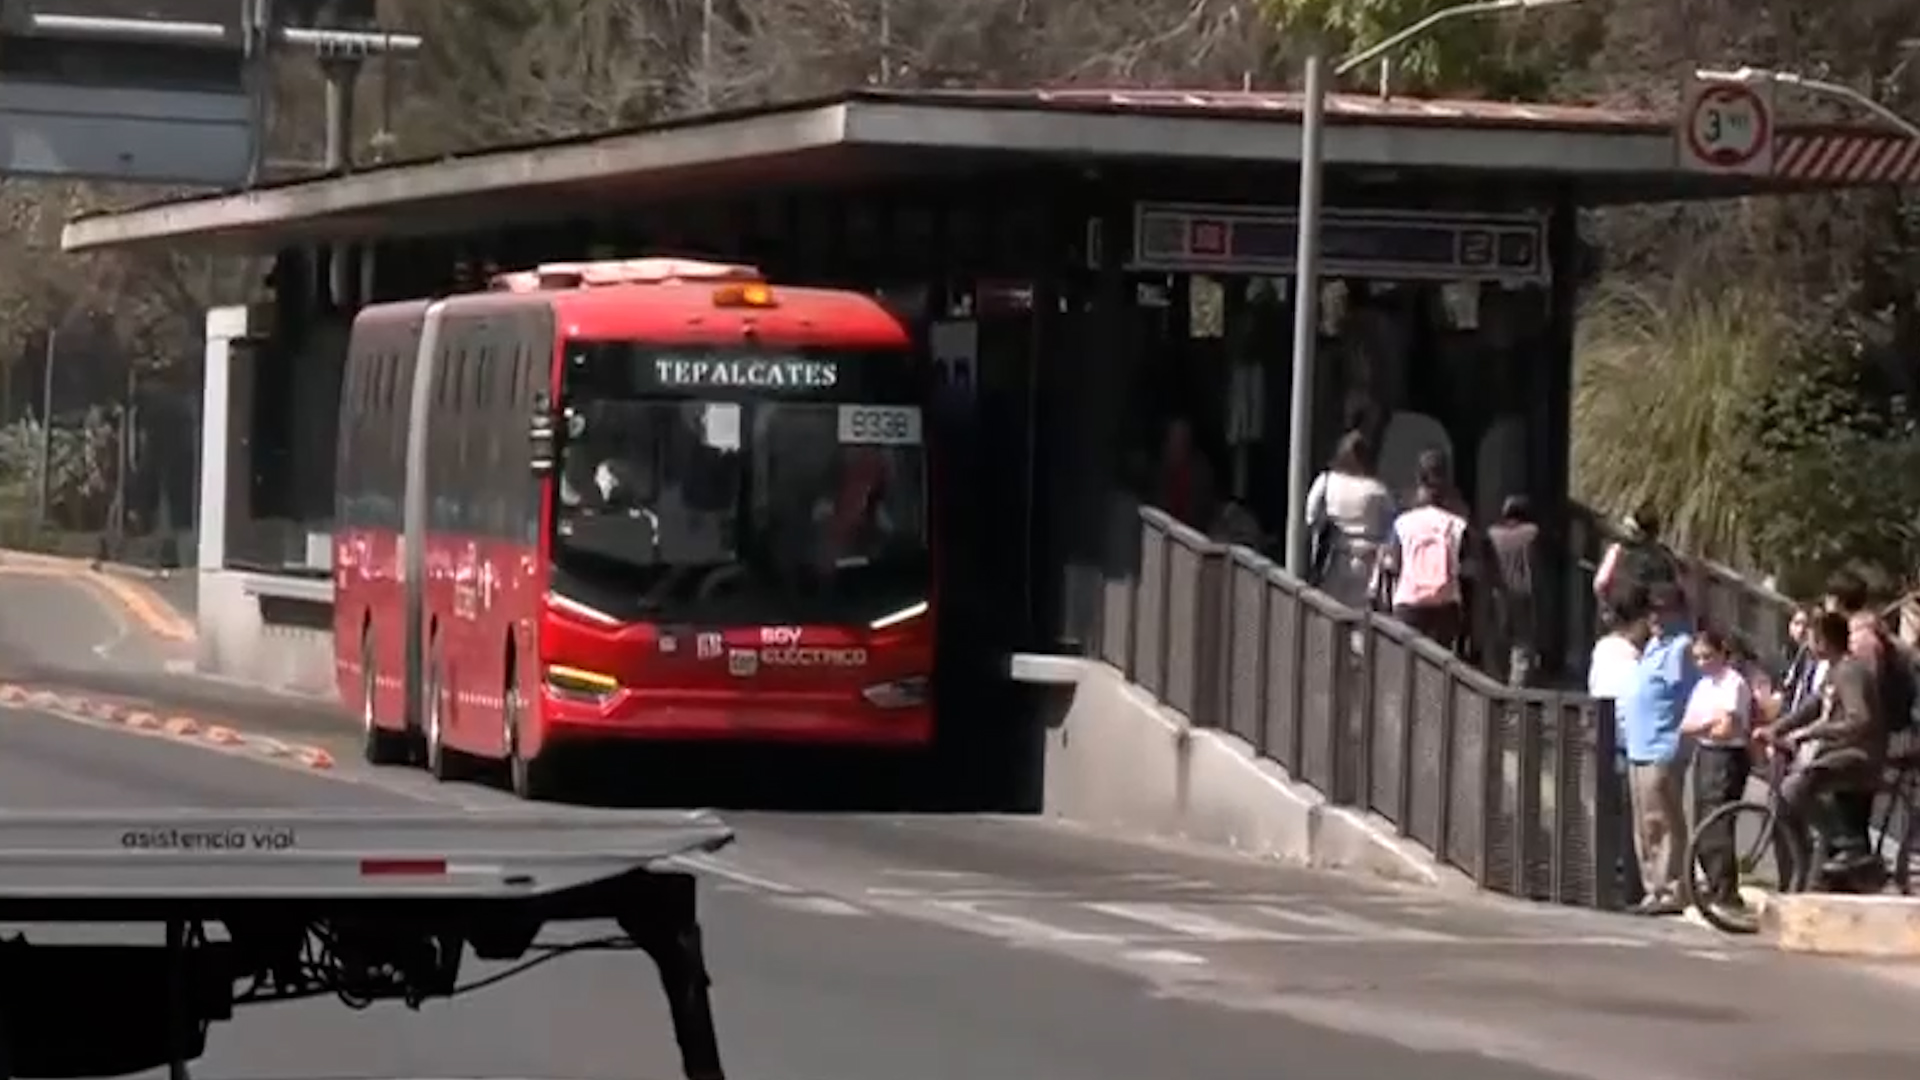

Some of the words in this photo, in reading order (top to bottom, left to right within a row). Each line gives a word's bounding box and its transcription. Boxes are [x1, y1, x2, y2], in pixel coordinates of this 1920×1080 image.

[1704, 108, 1721, 143] 3
[655, 359, 838, 386] TEPALCATES
[121, 829, 246, 849] asistencia
[252, 828, 296, 850] vial
